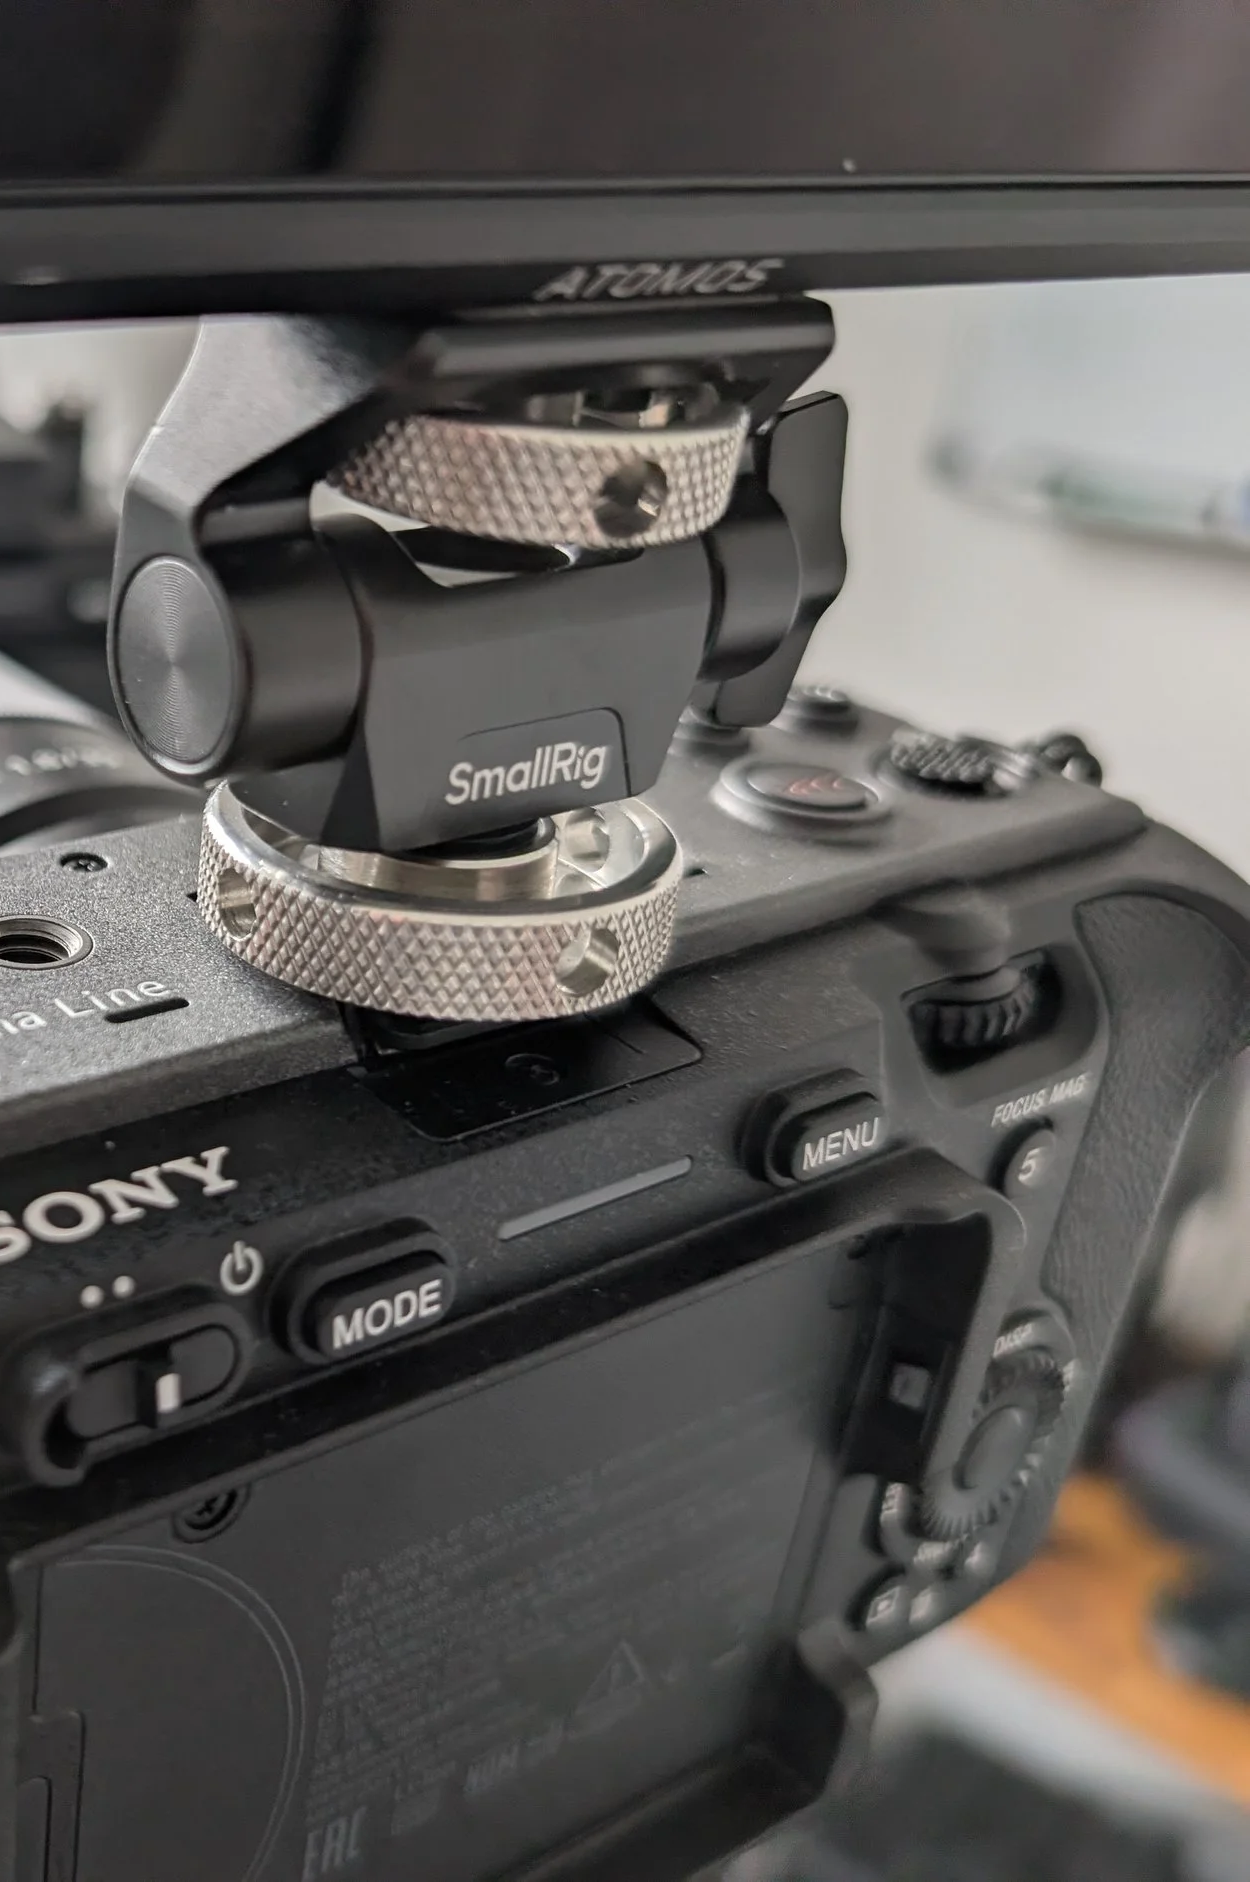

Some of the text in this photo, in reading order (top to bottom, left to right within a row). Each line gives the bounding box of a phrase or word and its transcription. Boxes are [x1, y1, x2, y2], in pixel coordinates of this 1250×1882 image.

[534, 258, 785, 299] ATOMOS
[445, 741, 606, 805] SmallRig
[54, 980, 172, 1018] Line
[991, 1089, 1047, 1128] FOCUS
[803, 1117, 878, 1171] MENU
[1018, 1147, 1040, 1181] 5
[333, 1280, 441, 1348] MODE
